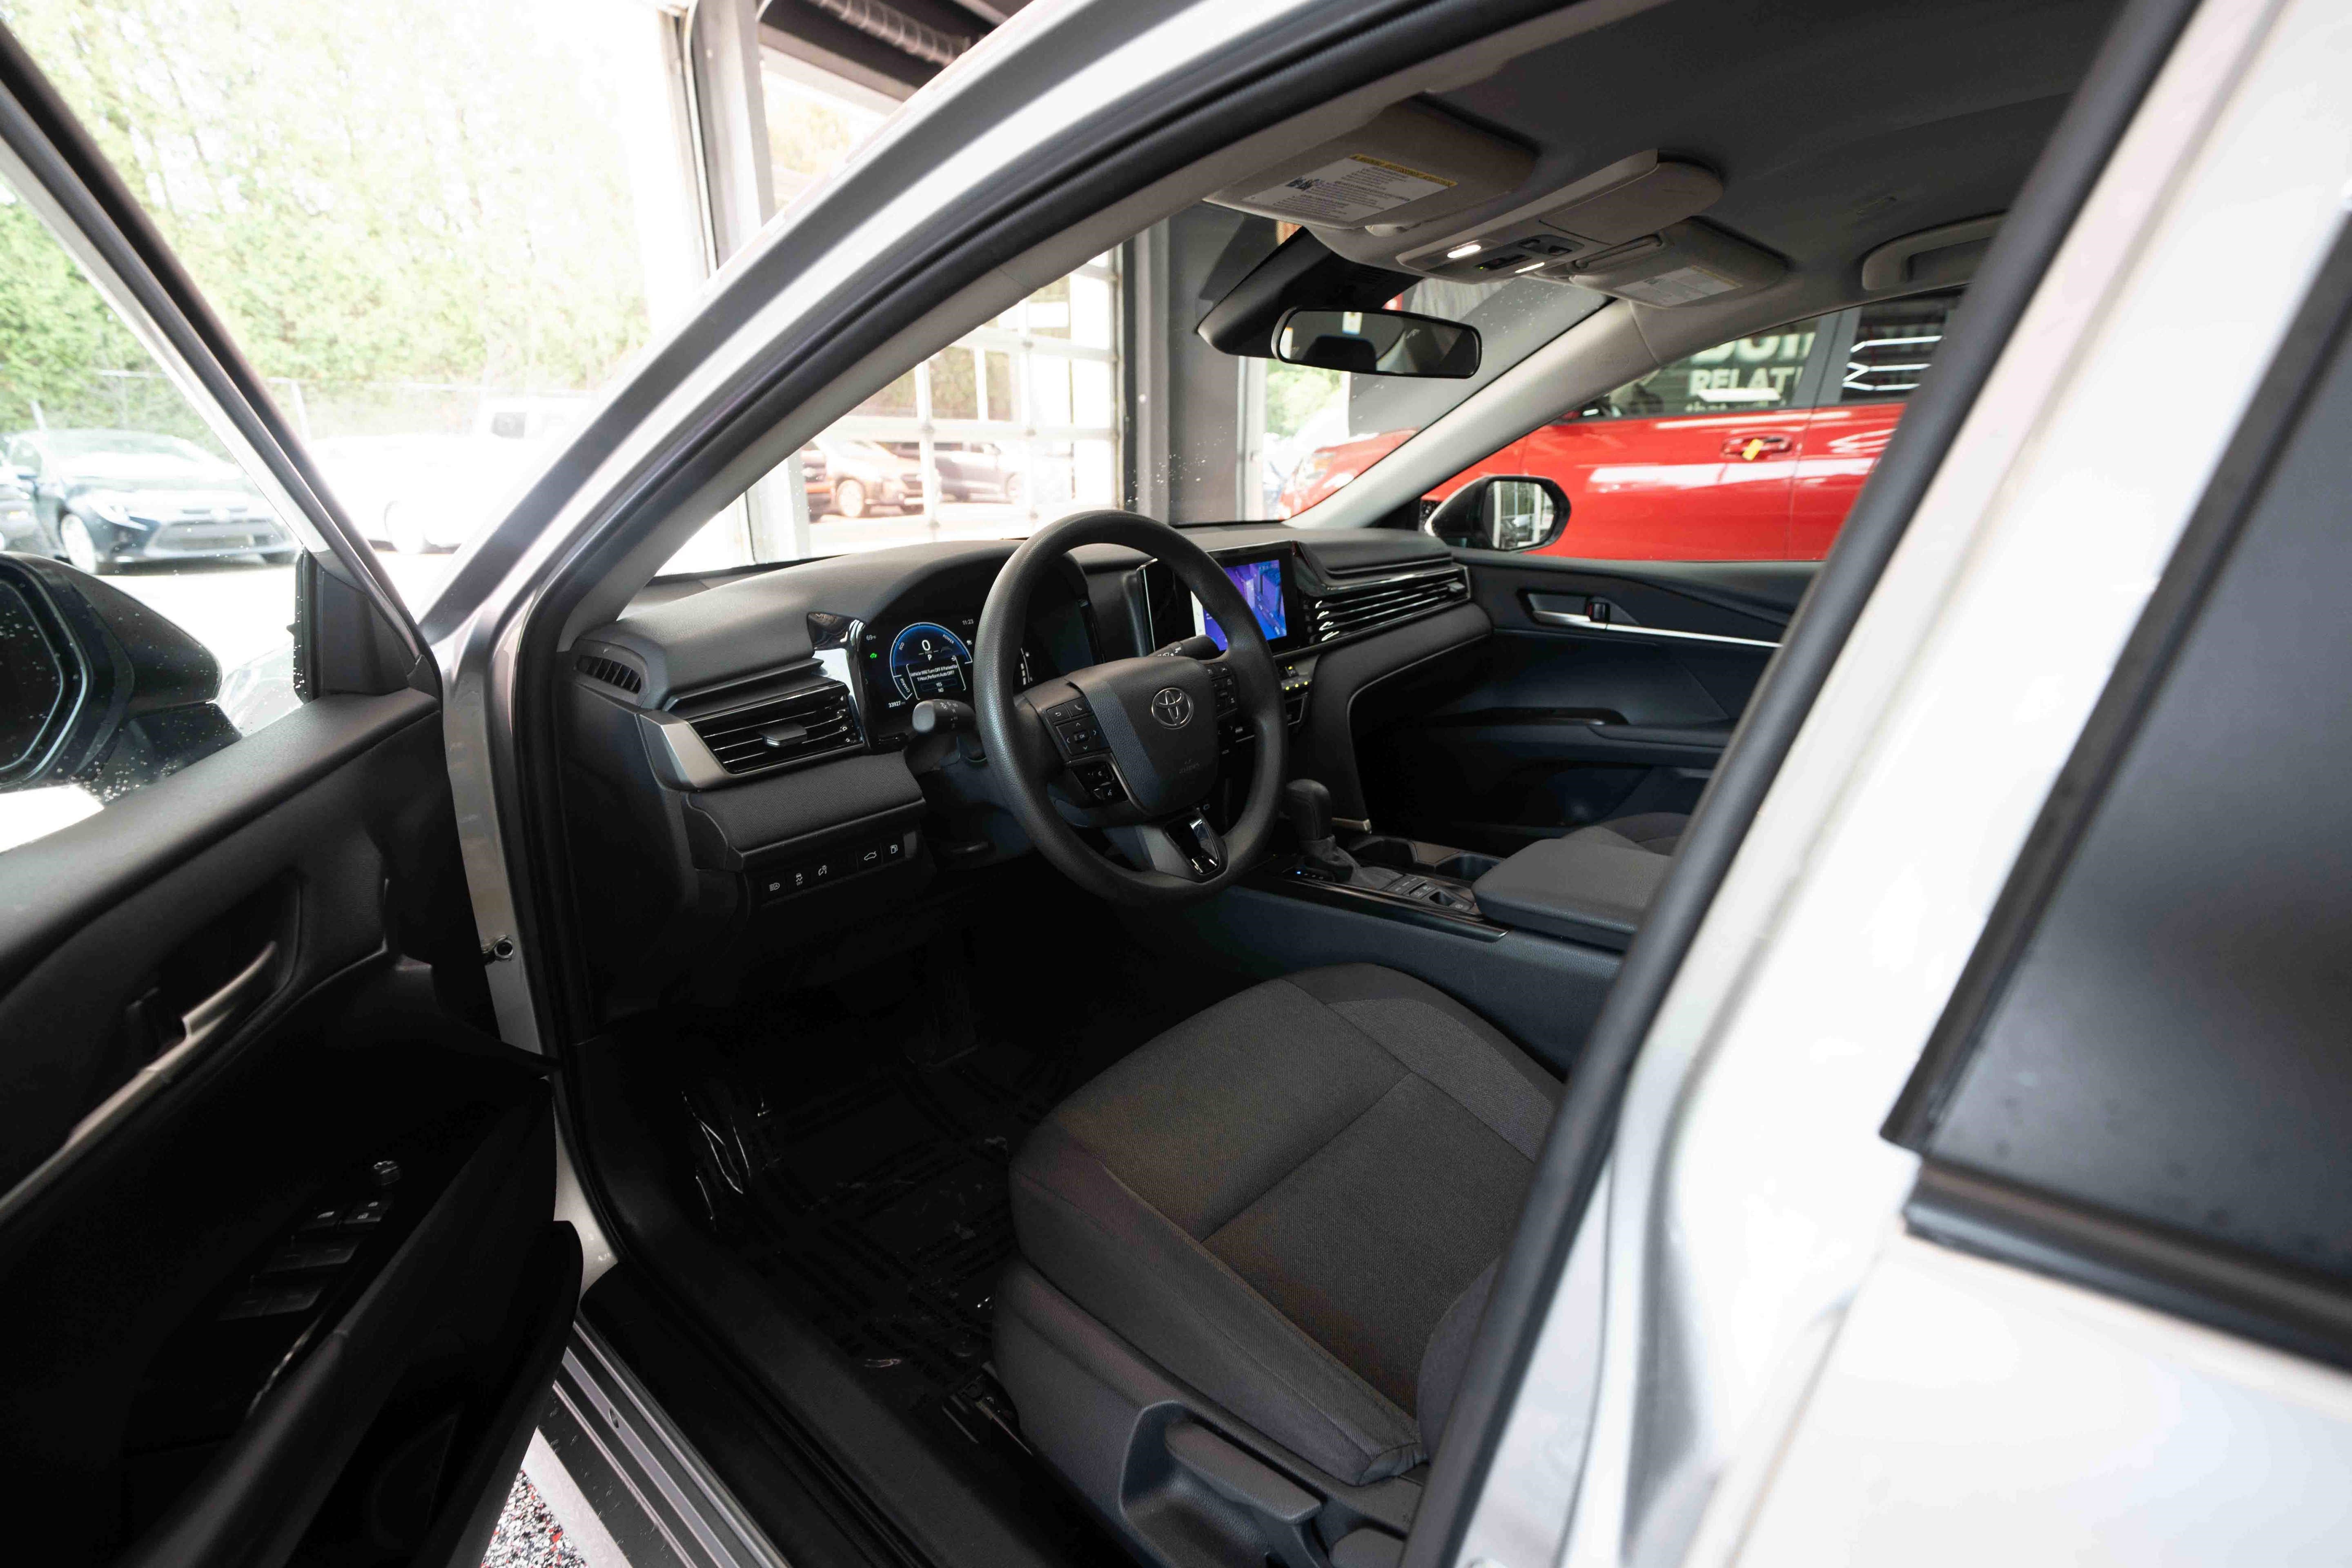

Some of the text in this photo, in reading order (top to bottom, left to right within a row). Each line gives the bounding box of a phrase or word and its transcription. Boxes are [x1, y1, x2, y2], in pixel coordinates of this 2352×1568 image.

[922, 639, 931, 651] 0
[943, 634, 954, 644] POWER
[900, 678, 910, 693] CHARGE
